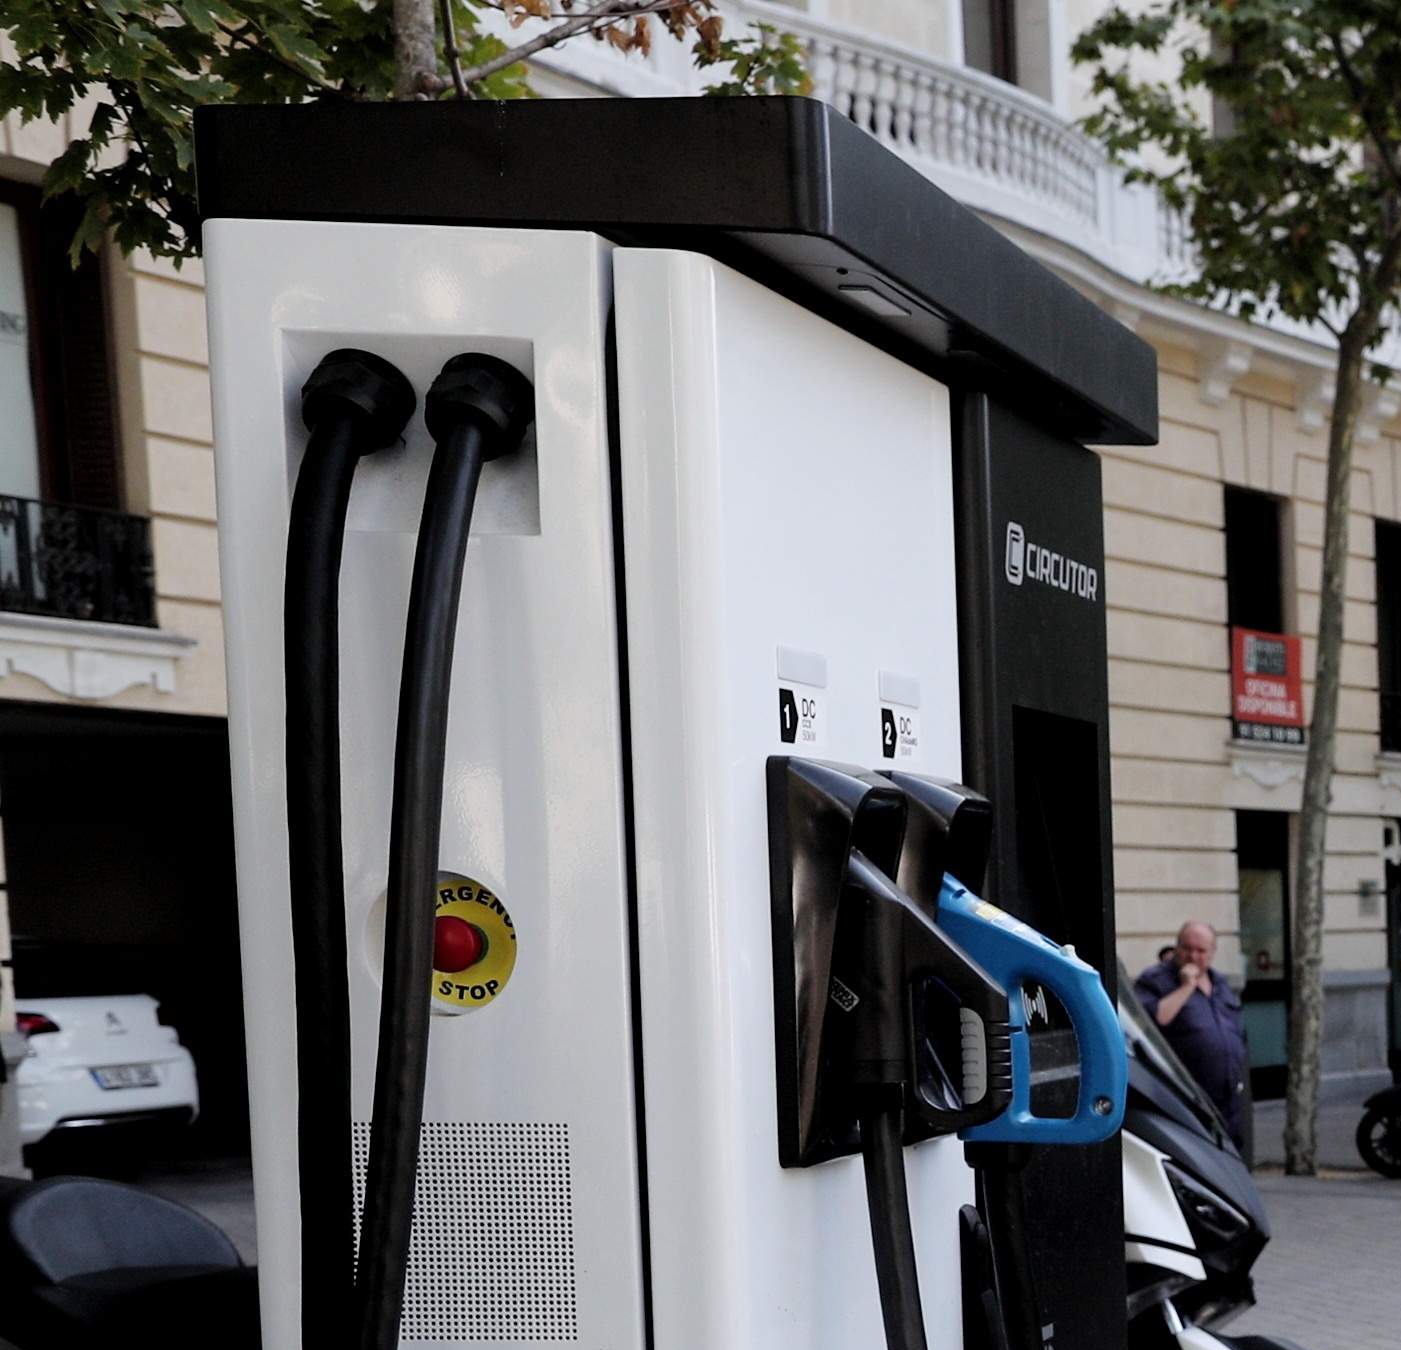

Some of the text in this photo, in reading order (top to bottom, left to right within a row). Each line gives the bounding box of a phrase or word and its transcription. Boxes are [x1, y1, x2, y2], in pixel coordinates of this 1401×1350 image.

[1026, 542, 1097, 602] CIRCUTOR
[784, 703, 791, 729] 1
[801, 698, 816, 719] DC
[884, 721, 893, 746] 2
[900, 716, 912, 736] DC
[438, 979, 499, 1000] STOP
